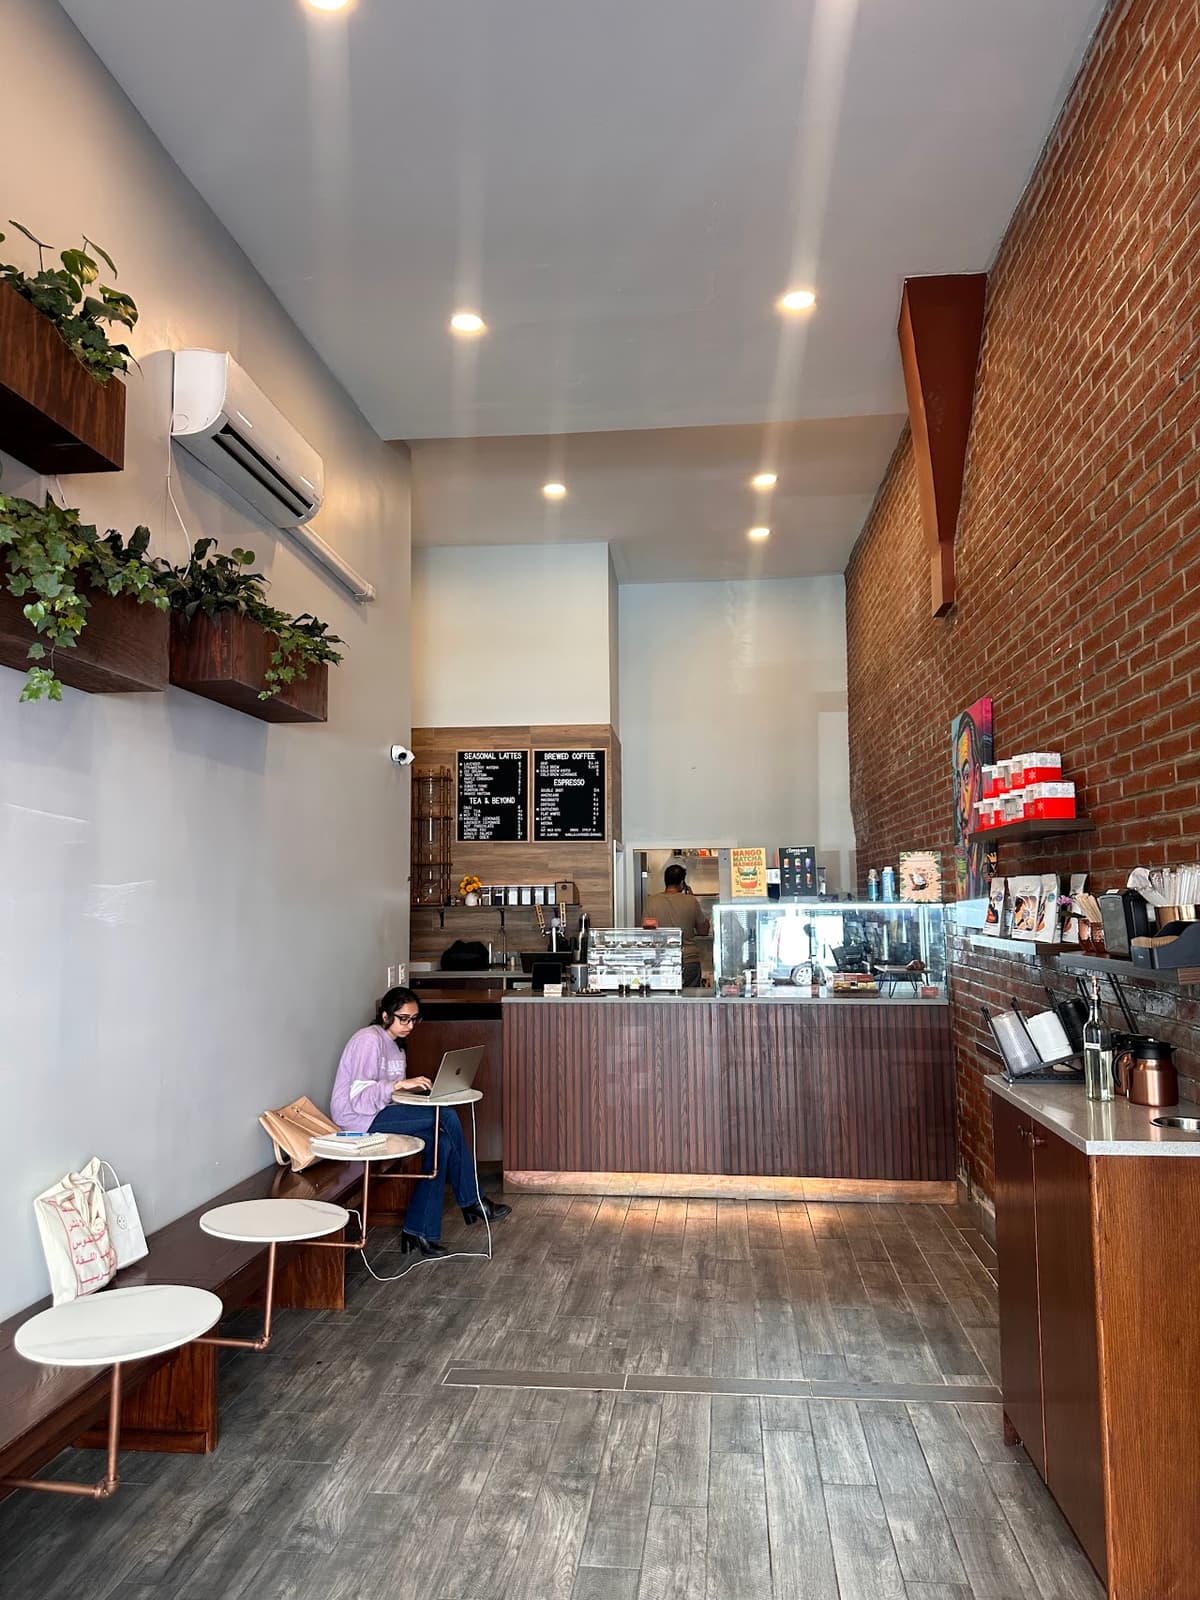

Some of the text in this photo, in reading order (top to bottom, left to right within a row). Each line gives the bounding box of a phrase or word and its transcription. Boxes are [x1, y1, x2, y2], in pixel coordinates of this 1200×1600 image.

[463, 752, 522, 760] SEASONAL LATTES
[543, 752, 596, 760] BREWED COFFEE
[553, 779, 586, 787] ESPRESSO
[468, 796, 516, 804] TEA & BEYOND
[732, 849, 762, 857] MANGO
